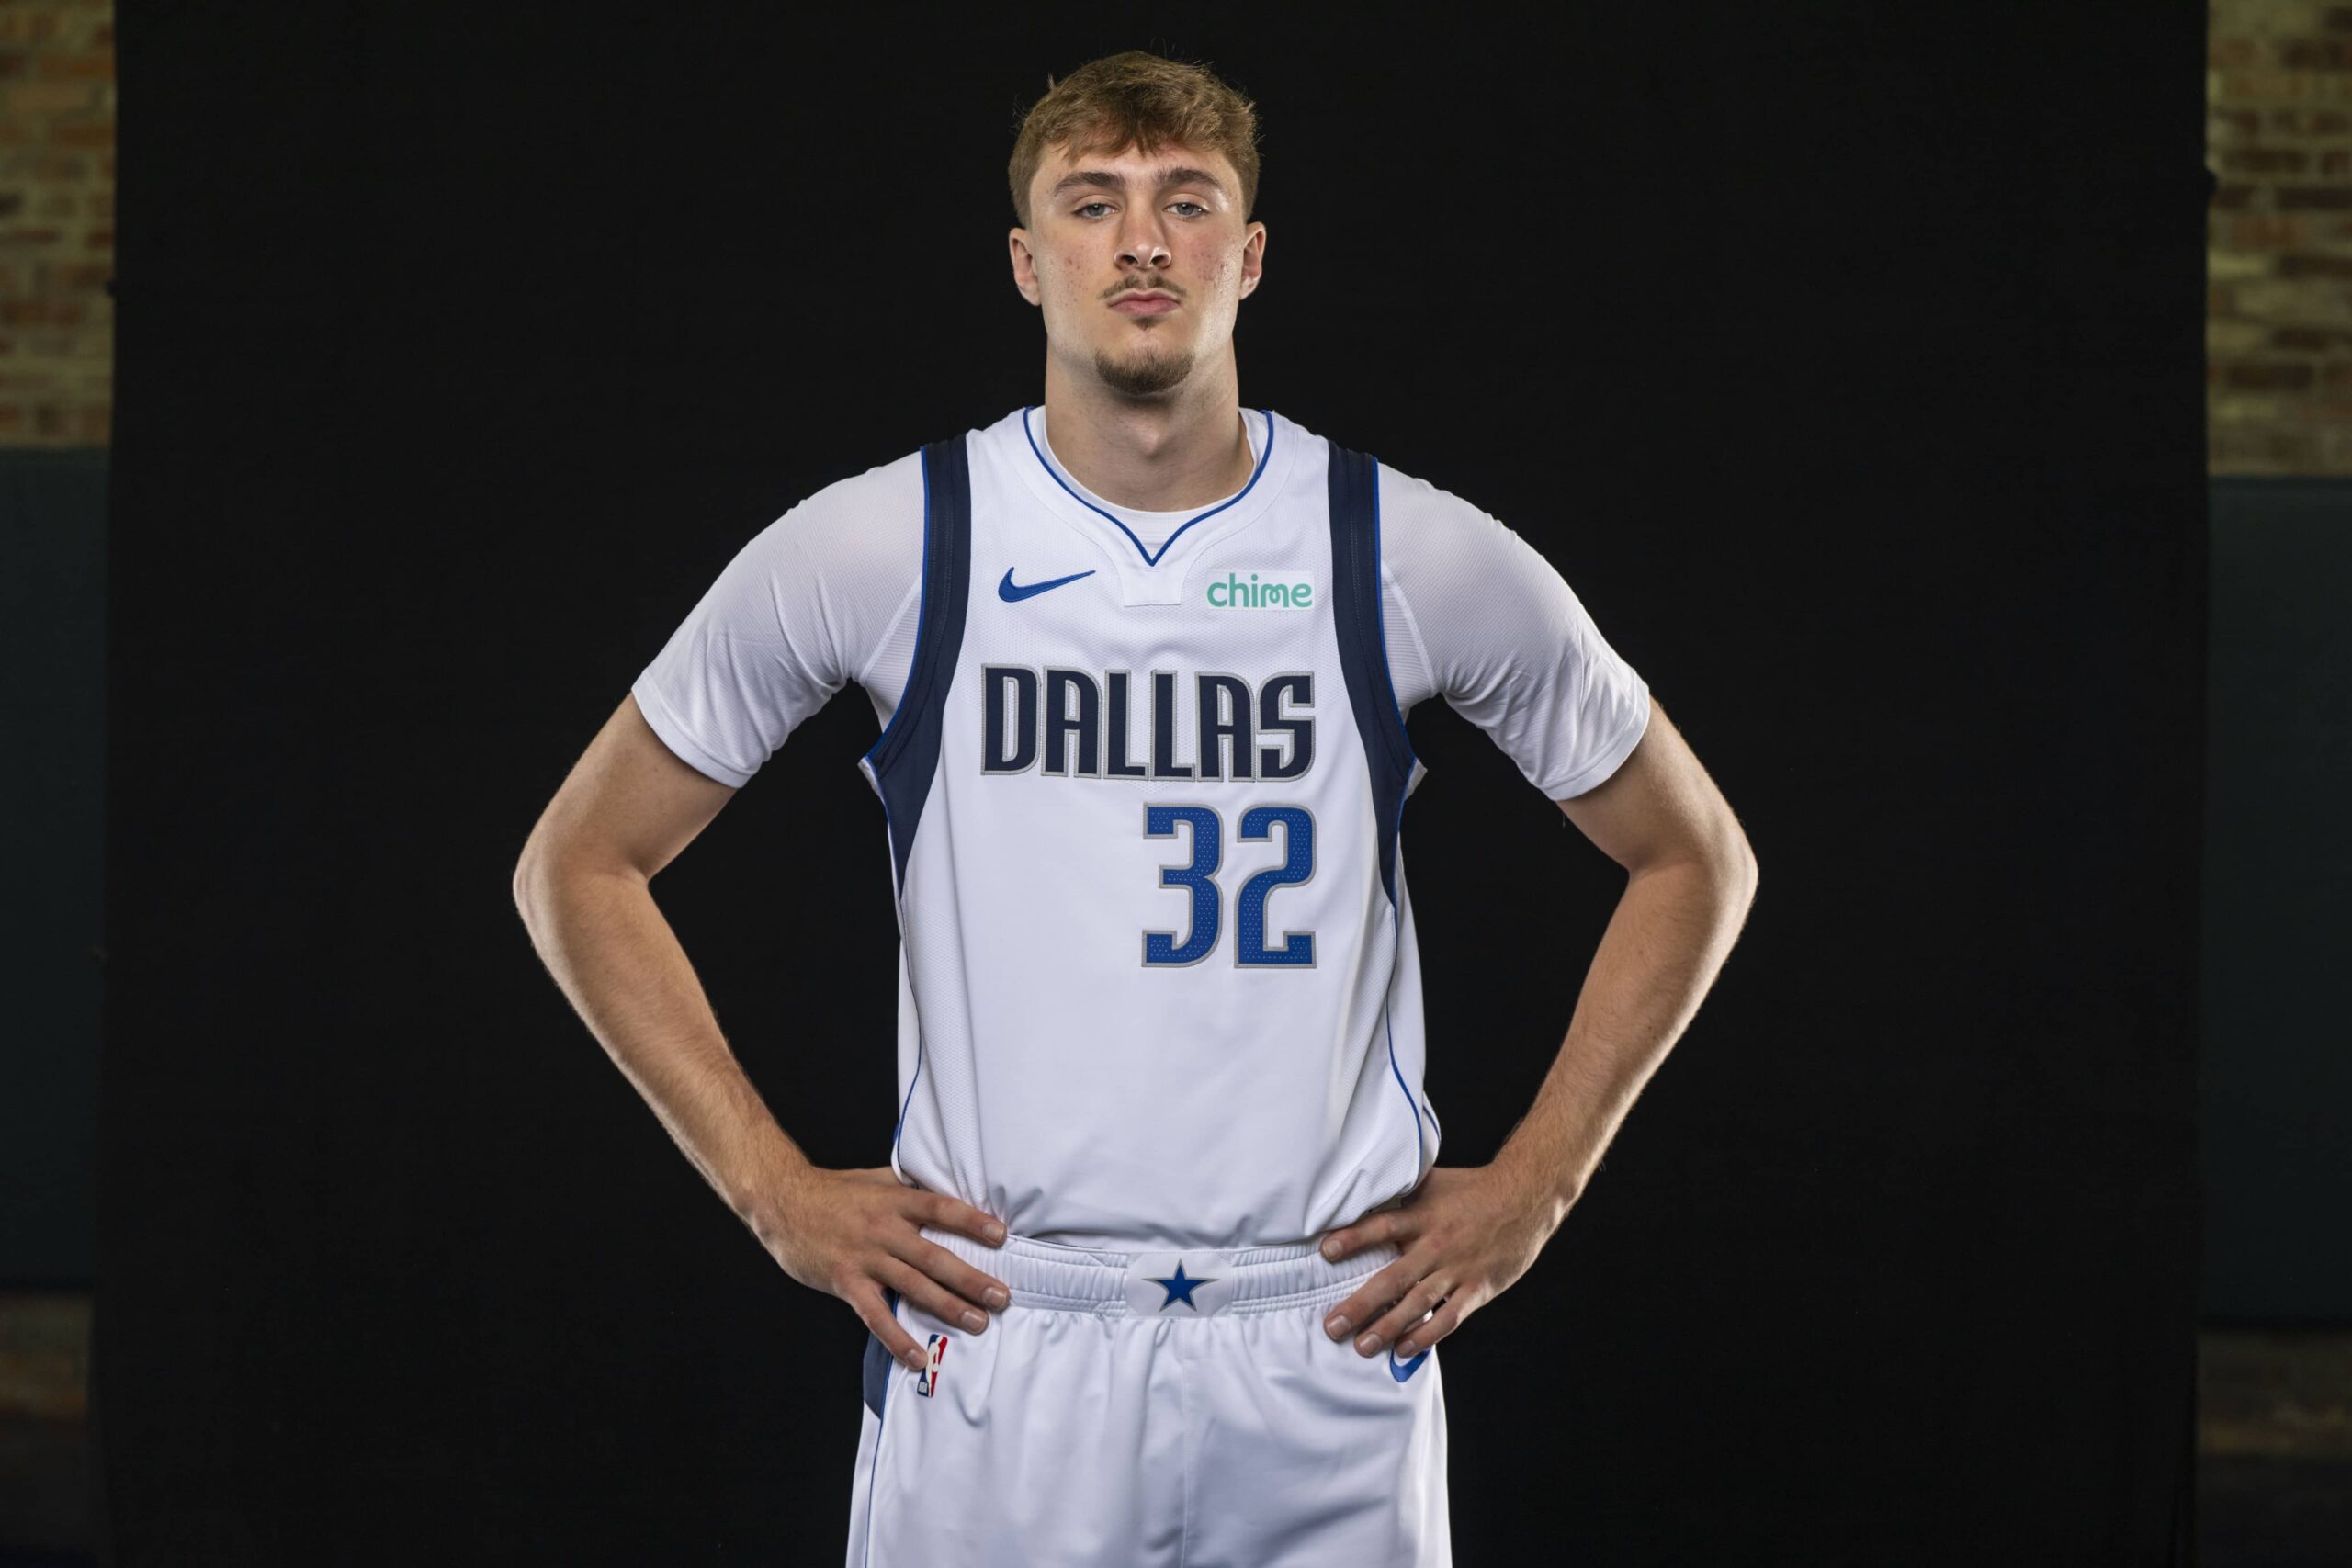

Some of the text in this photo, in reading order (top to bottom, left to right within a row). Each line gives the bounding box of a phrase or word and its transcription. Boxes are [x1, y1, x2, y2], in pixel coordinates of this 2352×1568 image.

[1207, 572, 1312, 608] chime
[980, 663, 1316, 783] DALLAS
[1141, 802, 1317, 969] 32
